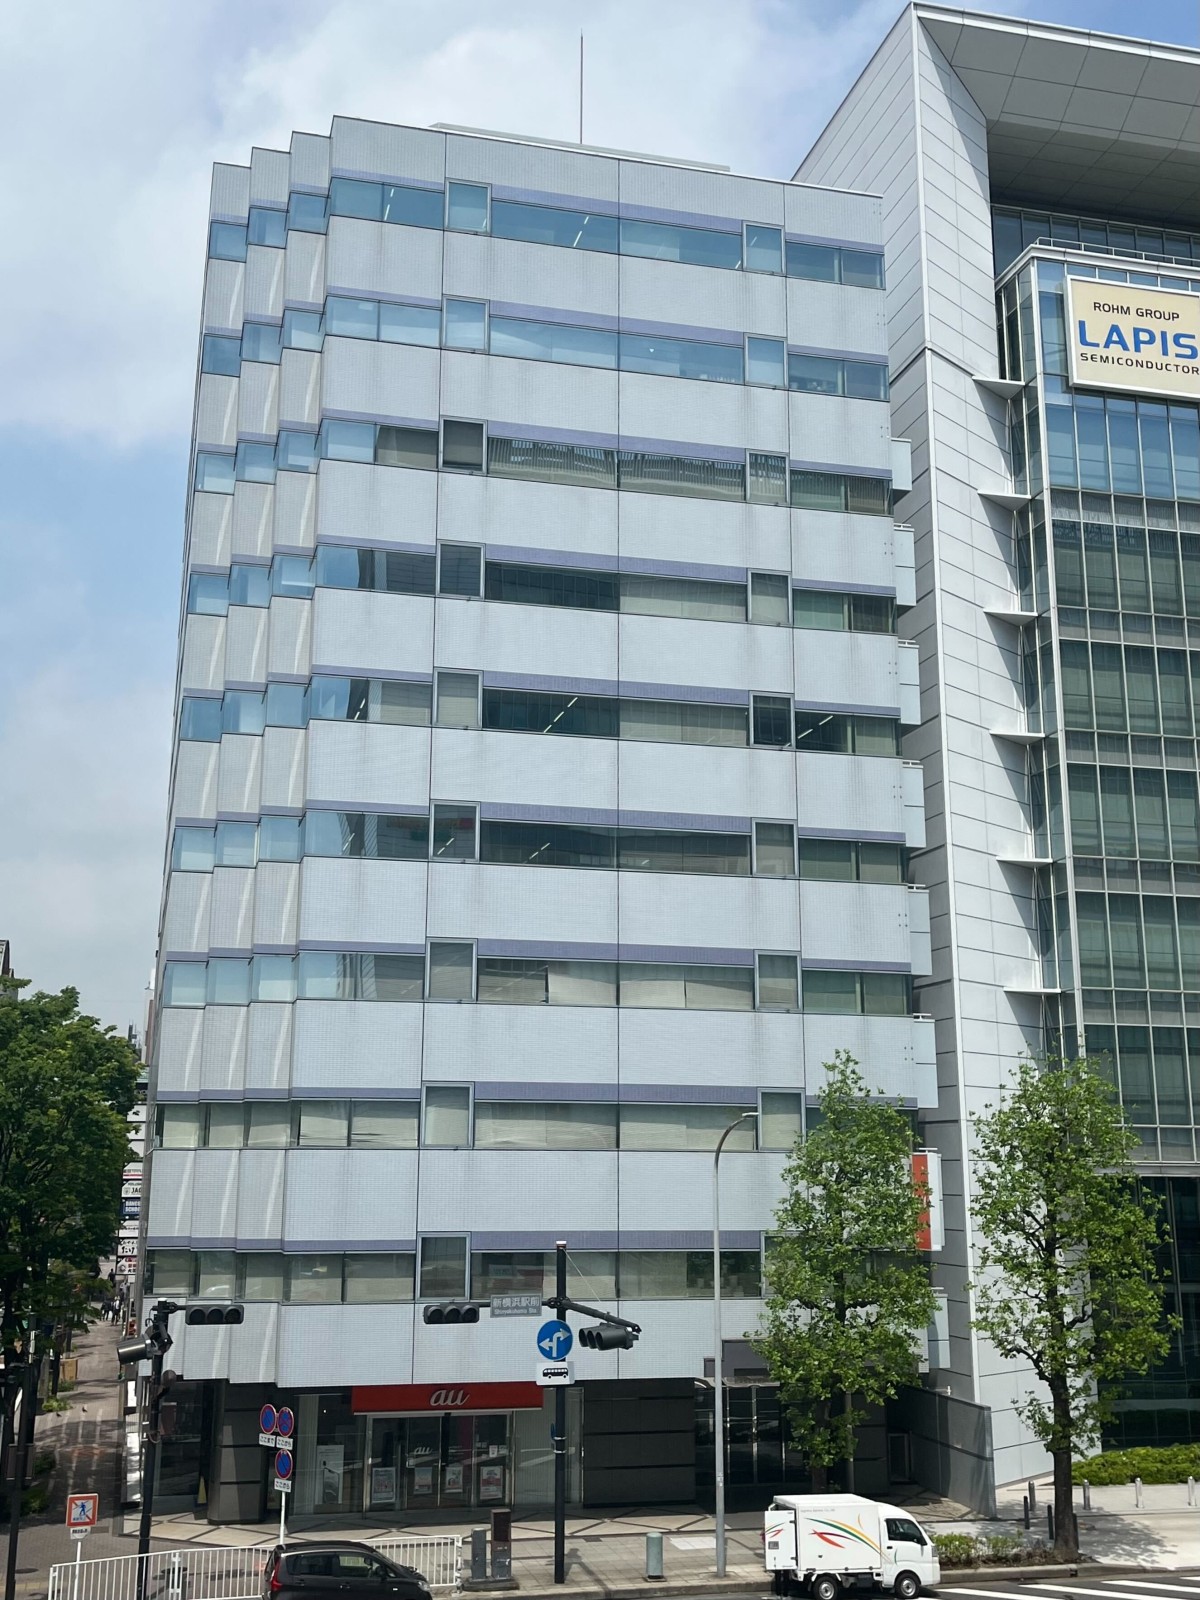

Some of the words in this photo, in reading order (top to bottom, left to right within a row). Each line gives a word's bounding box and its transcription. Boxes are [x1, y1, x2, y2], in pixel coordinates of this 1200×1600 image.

[1093, 302, 1131, 316] ROHM
[1135, 307, 1180, 321] GROUP
[1078, 320, 1199, 360] LAPIS
[1080, 353, 1200, 375] SEMICONDUCTOR
[493, 1297, 540, 1308] 新横浜駅前
[430, 1389, 470, 1407] au
[414, 1446, 431, 1455] au
